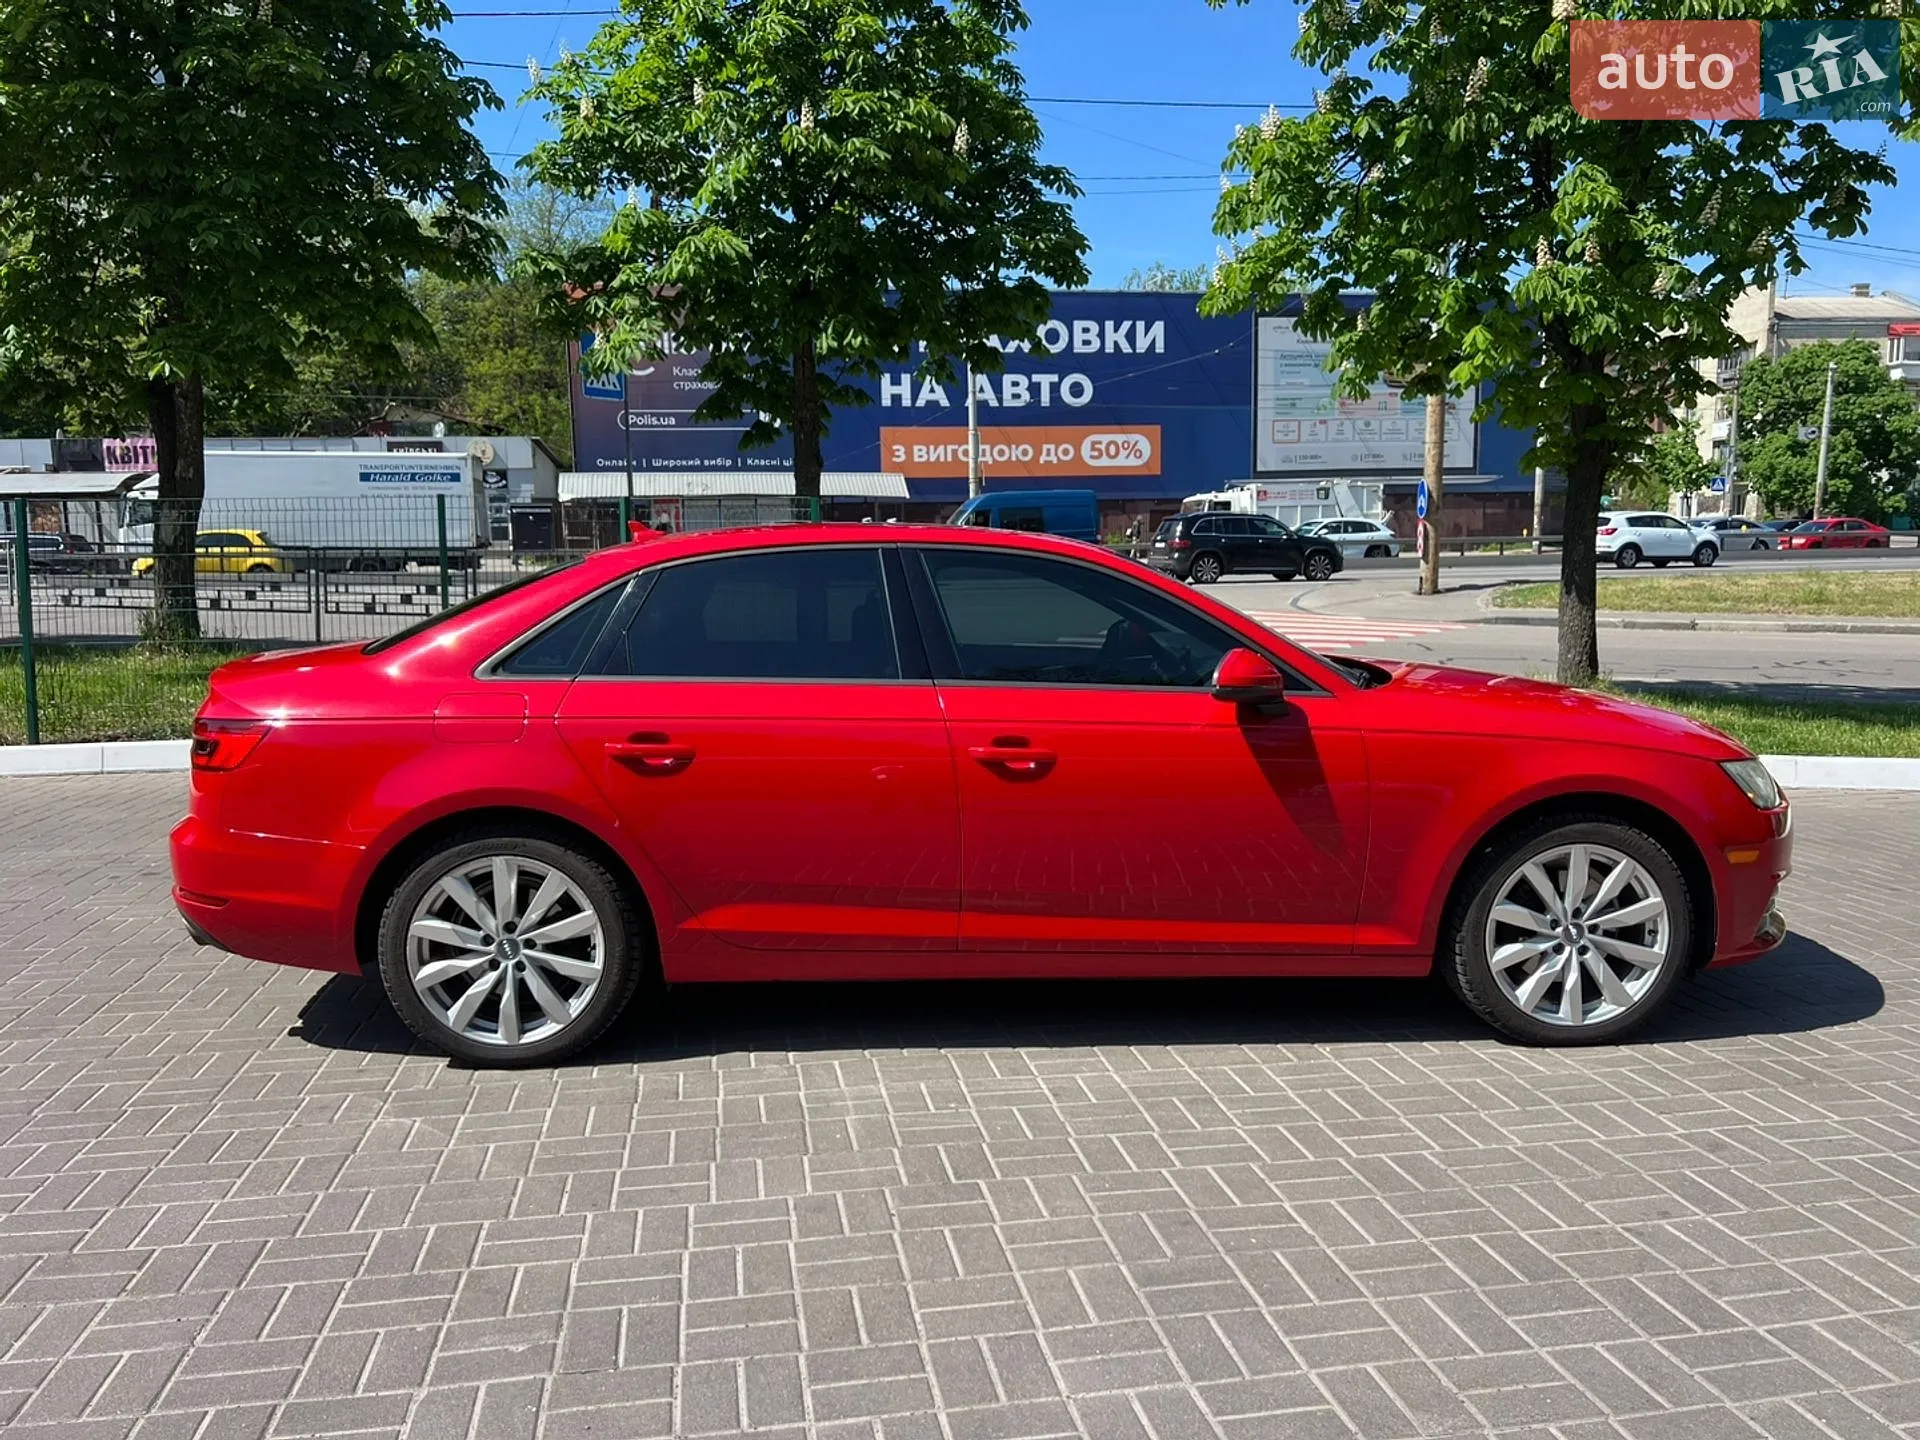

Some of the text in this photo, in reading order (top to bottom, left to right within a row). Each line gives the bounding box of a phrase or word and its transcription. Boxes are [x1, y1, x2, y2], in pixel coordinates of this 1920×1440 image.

[880, 372, 1094, 407] НА АВТО
[628, 414, 676, 425] Polis.ua
[913, 443, 1034, 465] ВИГОДОЮ
[1039, 443, 1075, 464] ДО
[1089, 439, 1143, 460] 50%
[652, 458, 700, 468] Широкий
[704, 458, 732, 467] вибір
[746, 457, 780, 466] Класні
